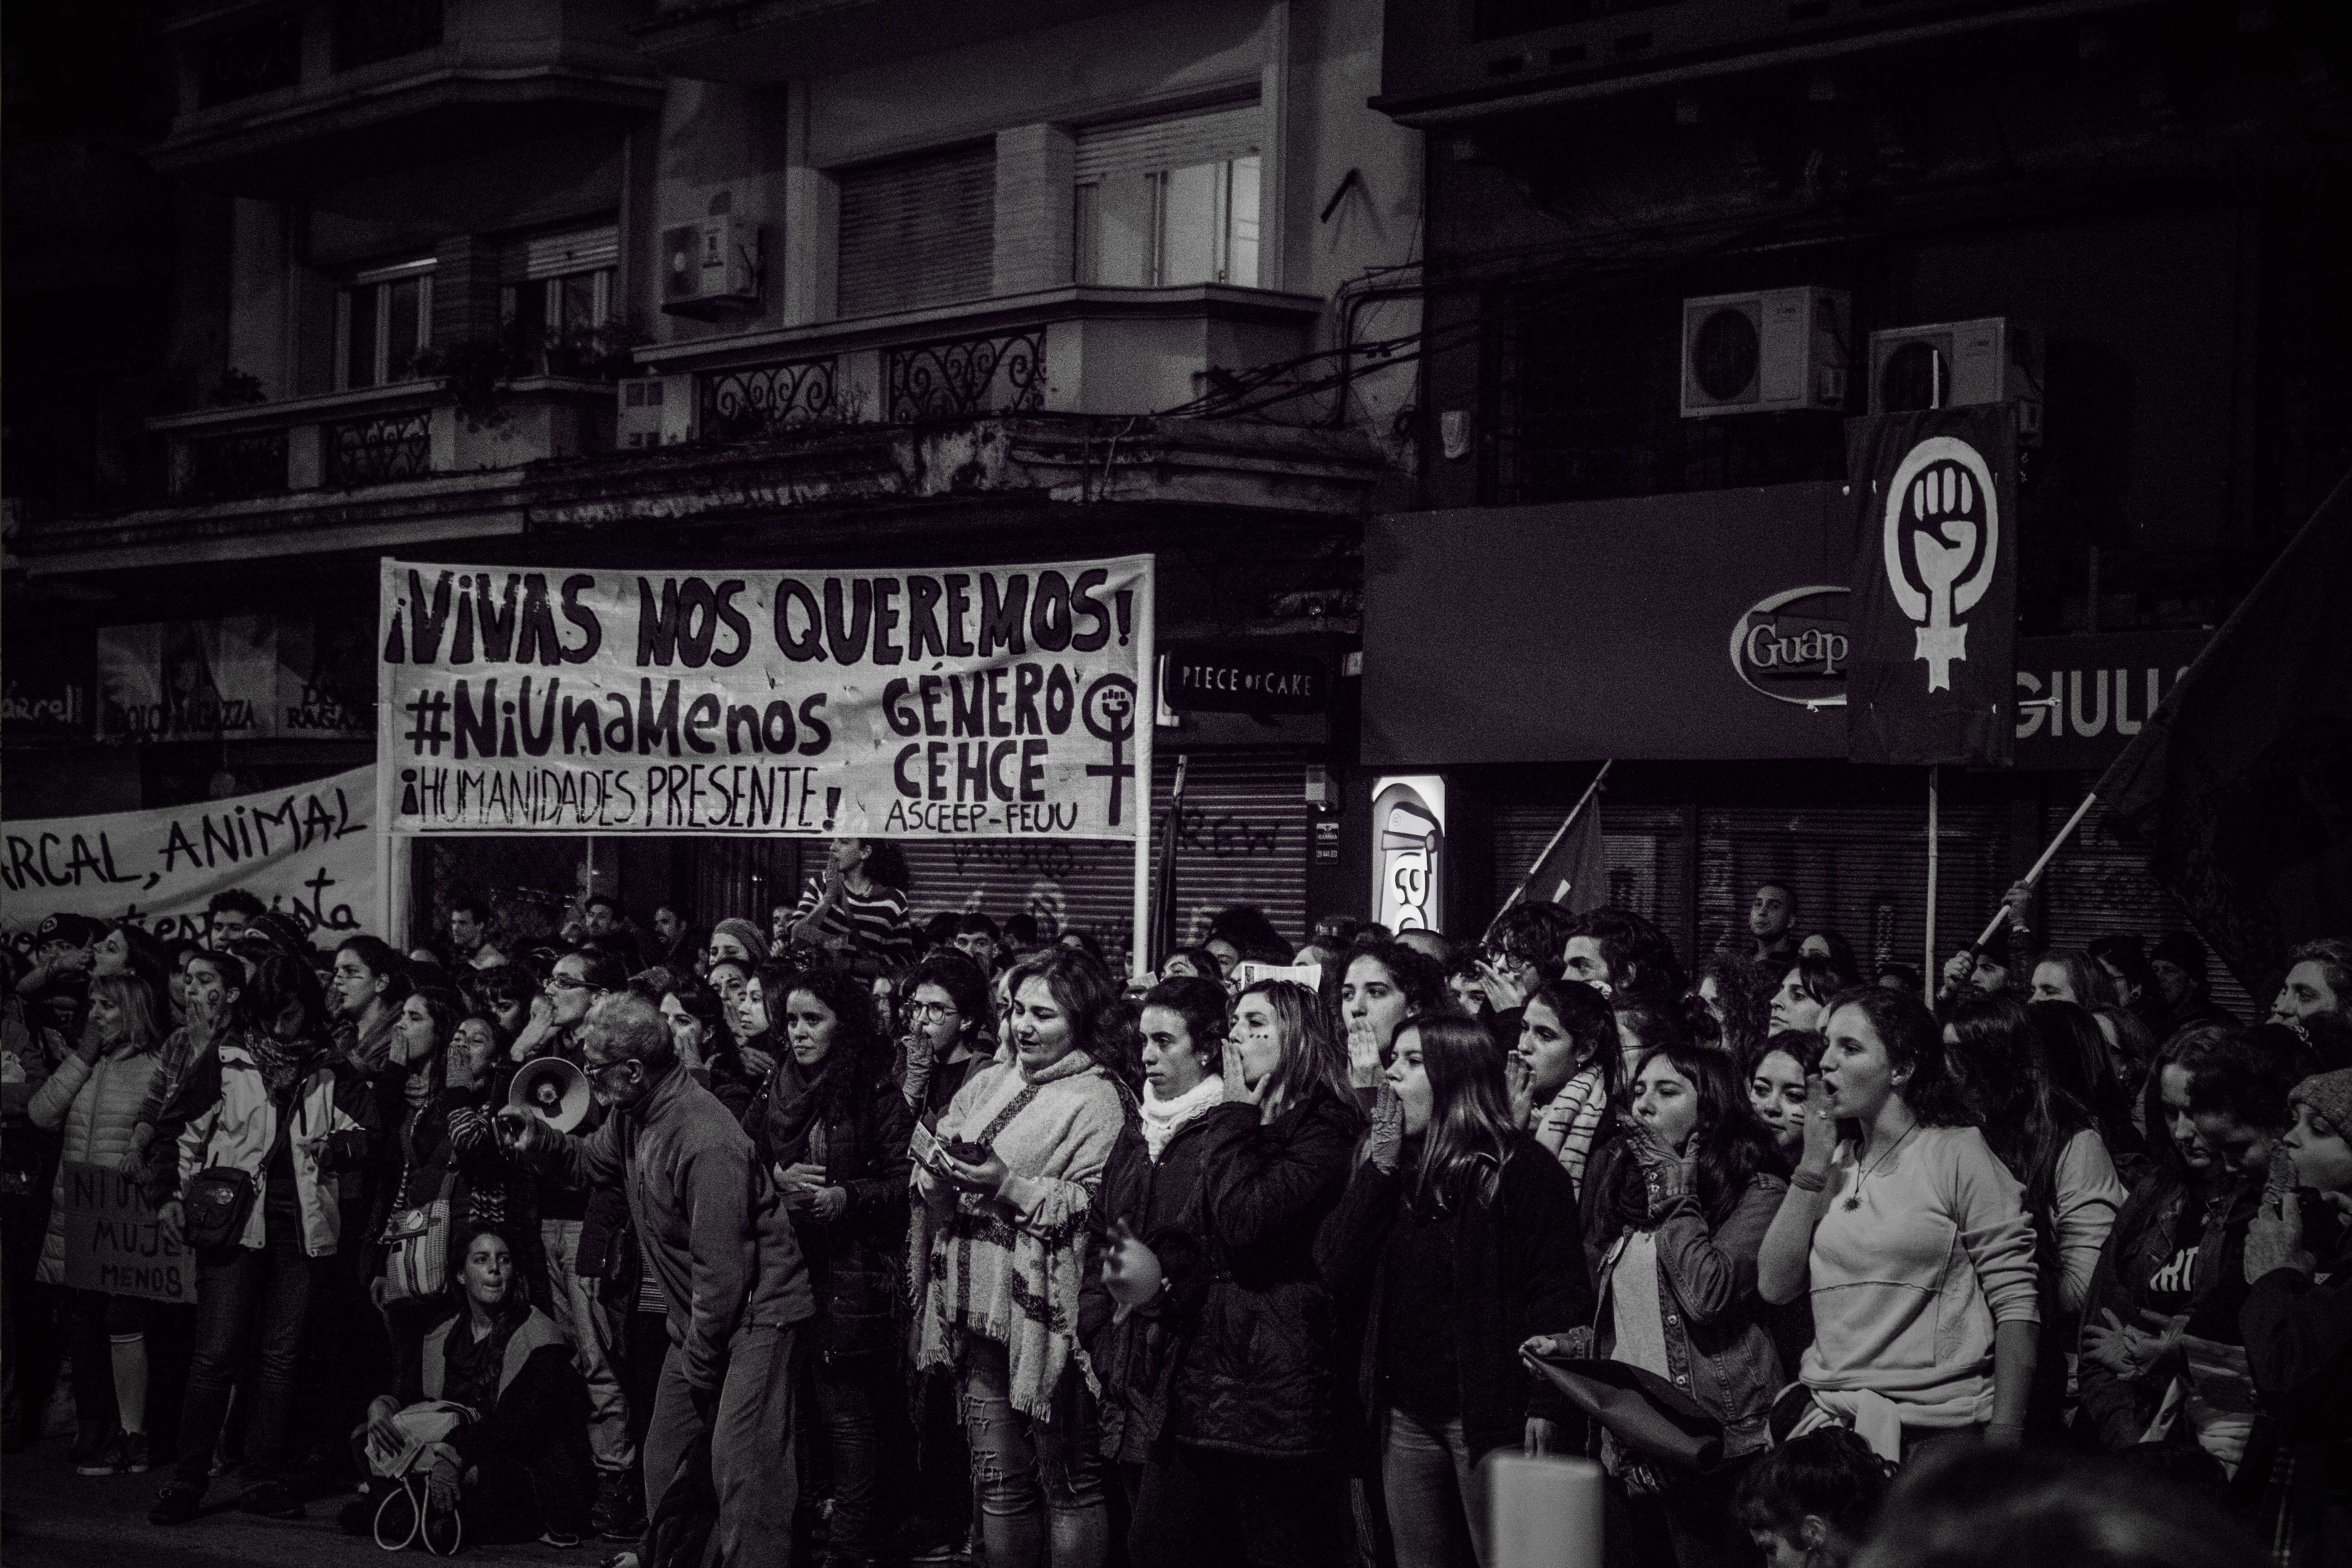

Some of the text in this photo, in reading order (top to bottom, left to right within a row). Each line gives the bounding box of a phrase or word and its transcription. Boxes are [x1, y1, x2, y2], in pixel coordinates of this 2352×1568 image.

[637, 577, 751, 668] NOS
[774, 569, 1133, 665] QUEREMOS!
[883, 662, 1074, 738] GÉNERO
[1182, 666, 1239, 691] PIECE
[1264, 672, 1312, 696] CAKE
[405, 676, 832, 758] #NiUnaMenos
[647, 765, 841, 831] PRESENTE!
[894, 739, 1049, 803] CEHCE
[885, 799, 1078, 833] ASCEEP-FEUU
[74, 1169, 105, 1208] NI
[101, 1263, 183, 1297] MENOS
